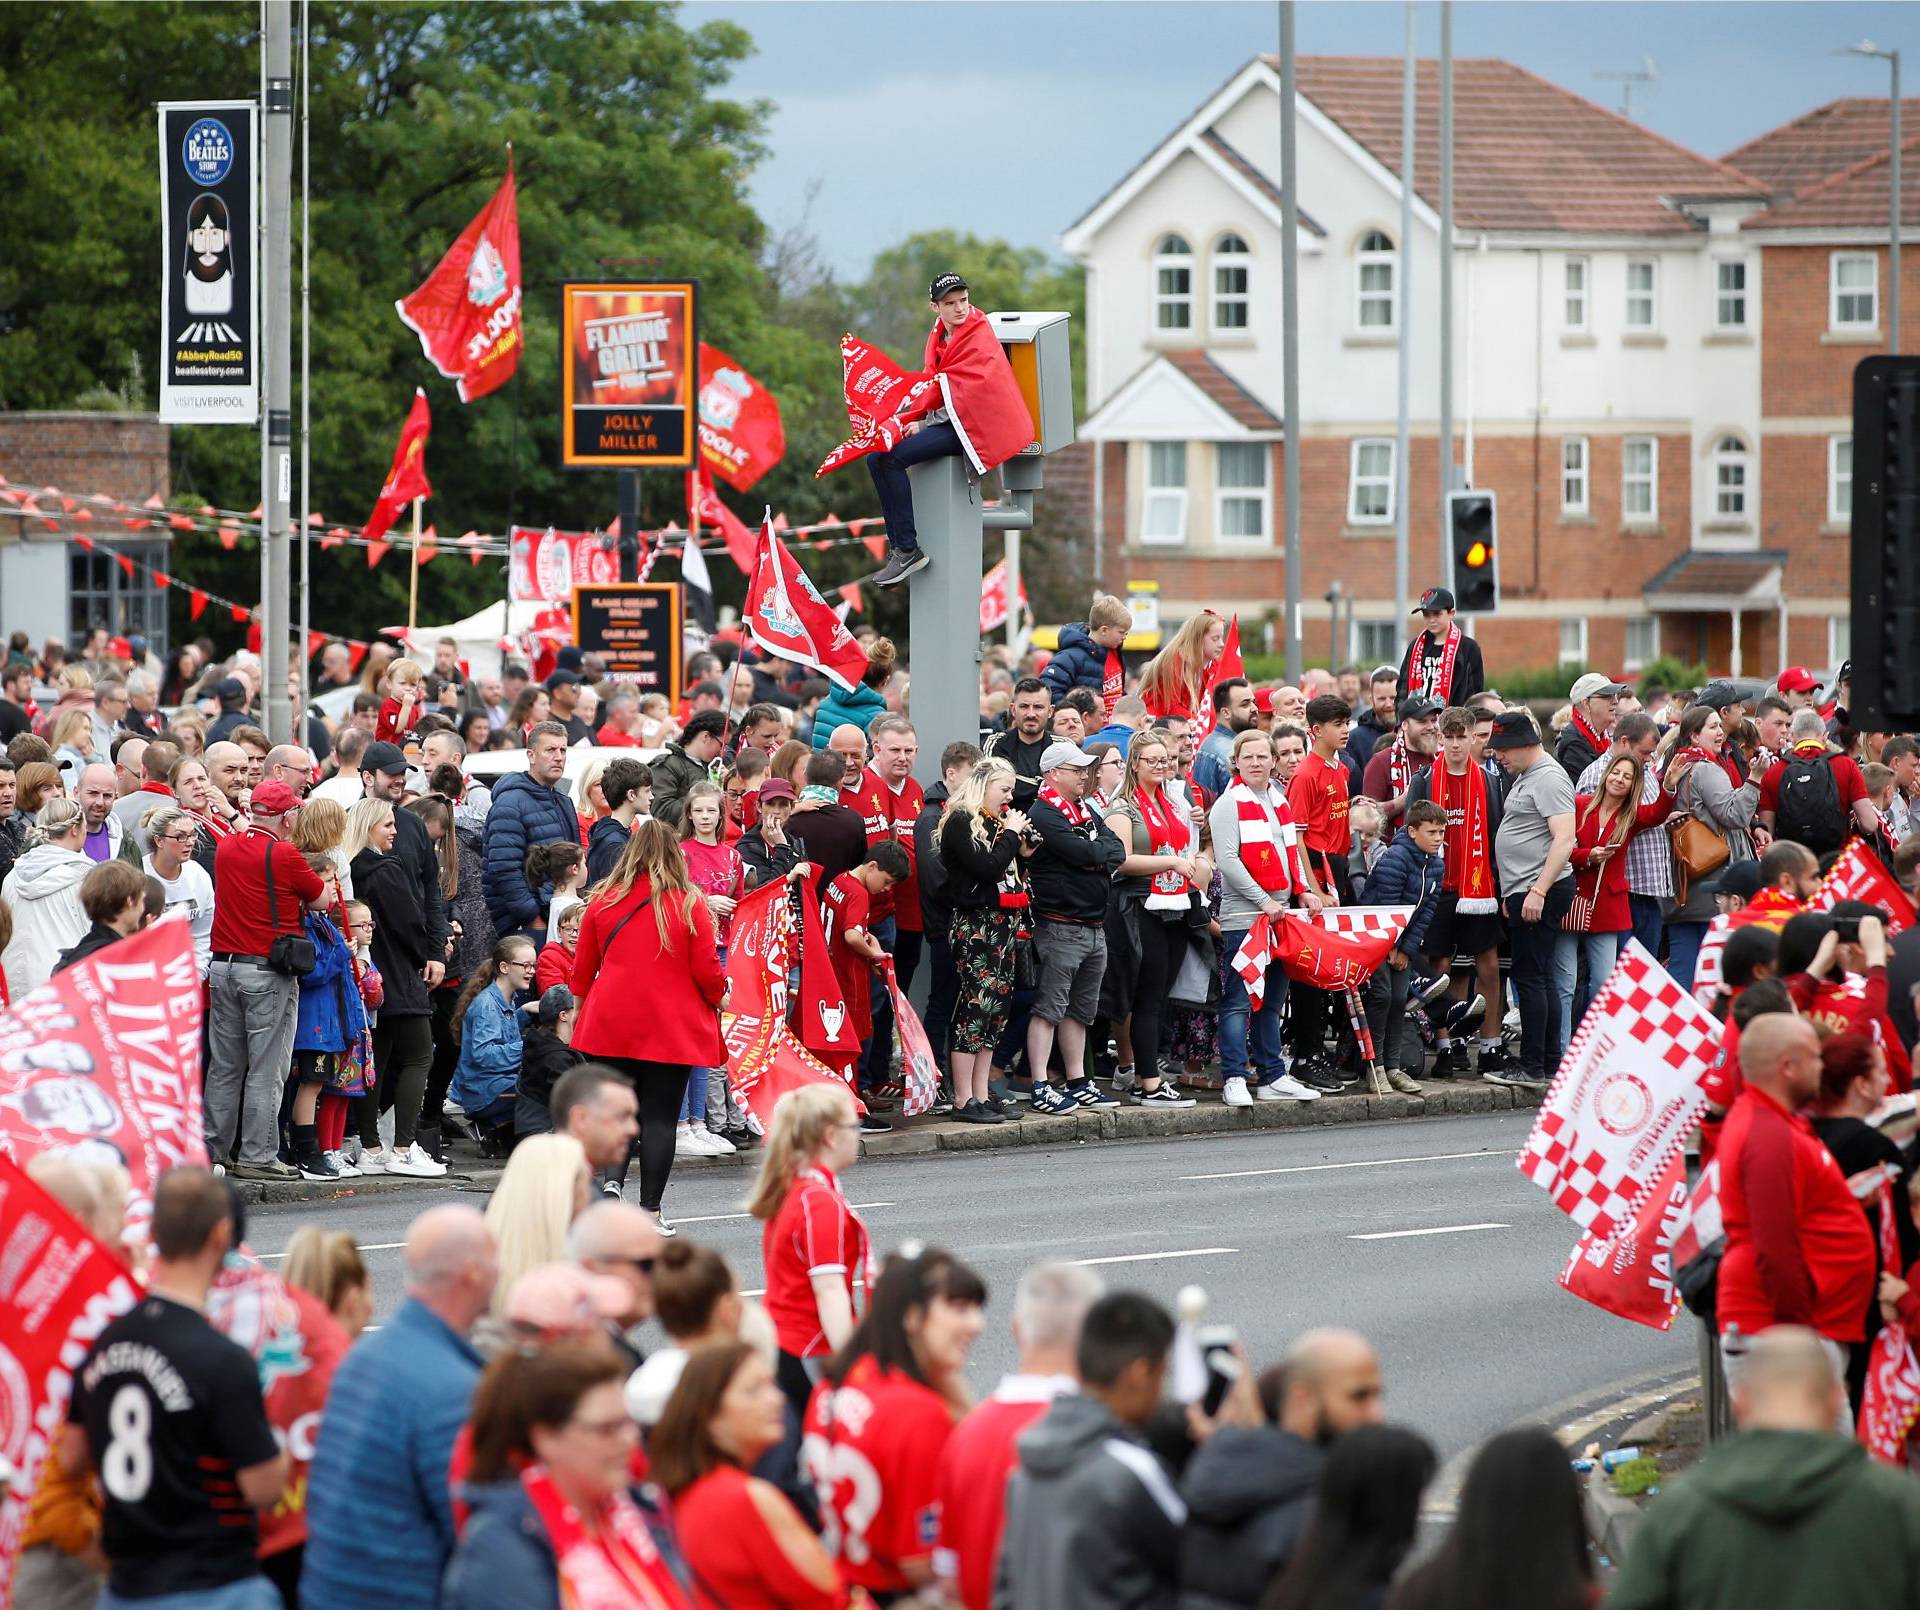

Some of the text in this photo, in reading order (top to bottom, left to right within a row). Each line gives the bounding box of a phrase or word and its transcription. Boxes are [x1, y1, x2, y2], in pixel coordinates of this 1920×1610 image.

[188, 139, 229, 161] BEATLES
[198, 162, 218, 171] STORY
[584, 318, 669, 352] FLAMING
[176, 350, 244, 362] #AbbeyRoad50
[597, 341, 666, 376] GRILL
[174, 365, 245, 378] beatlesstory.com
[603, 414, 654, 431] JOLLY
[599, 435, 659, 449] MILLER
[612, 672, 658, 684] SPORTS
[826, 881, 846, 905] SALAH
[102, 1382, 154, 1504] 8
